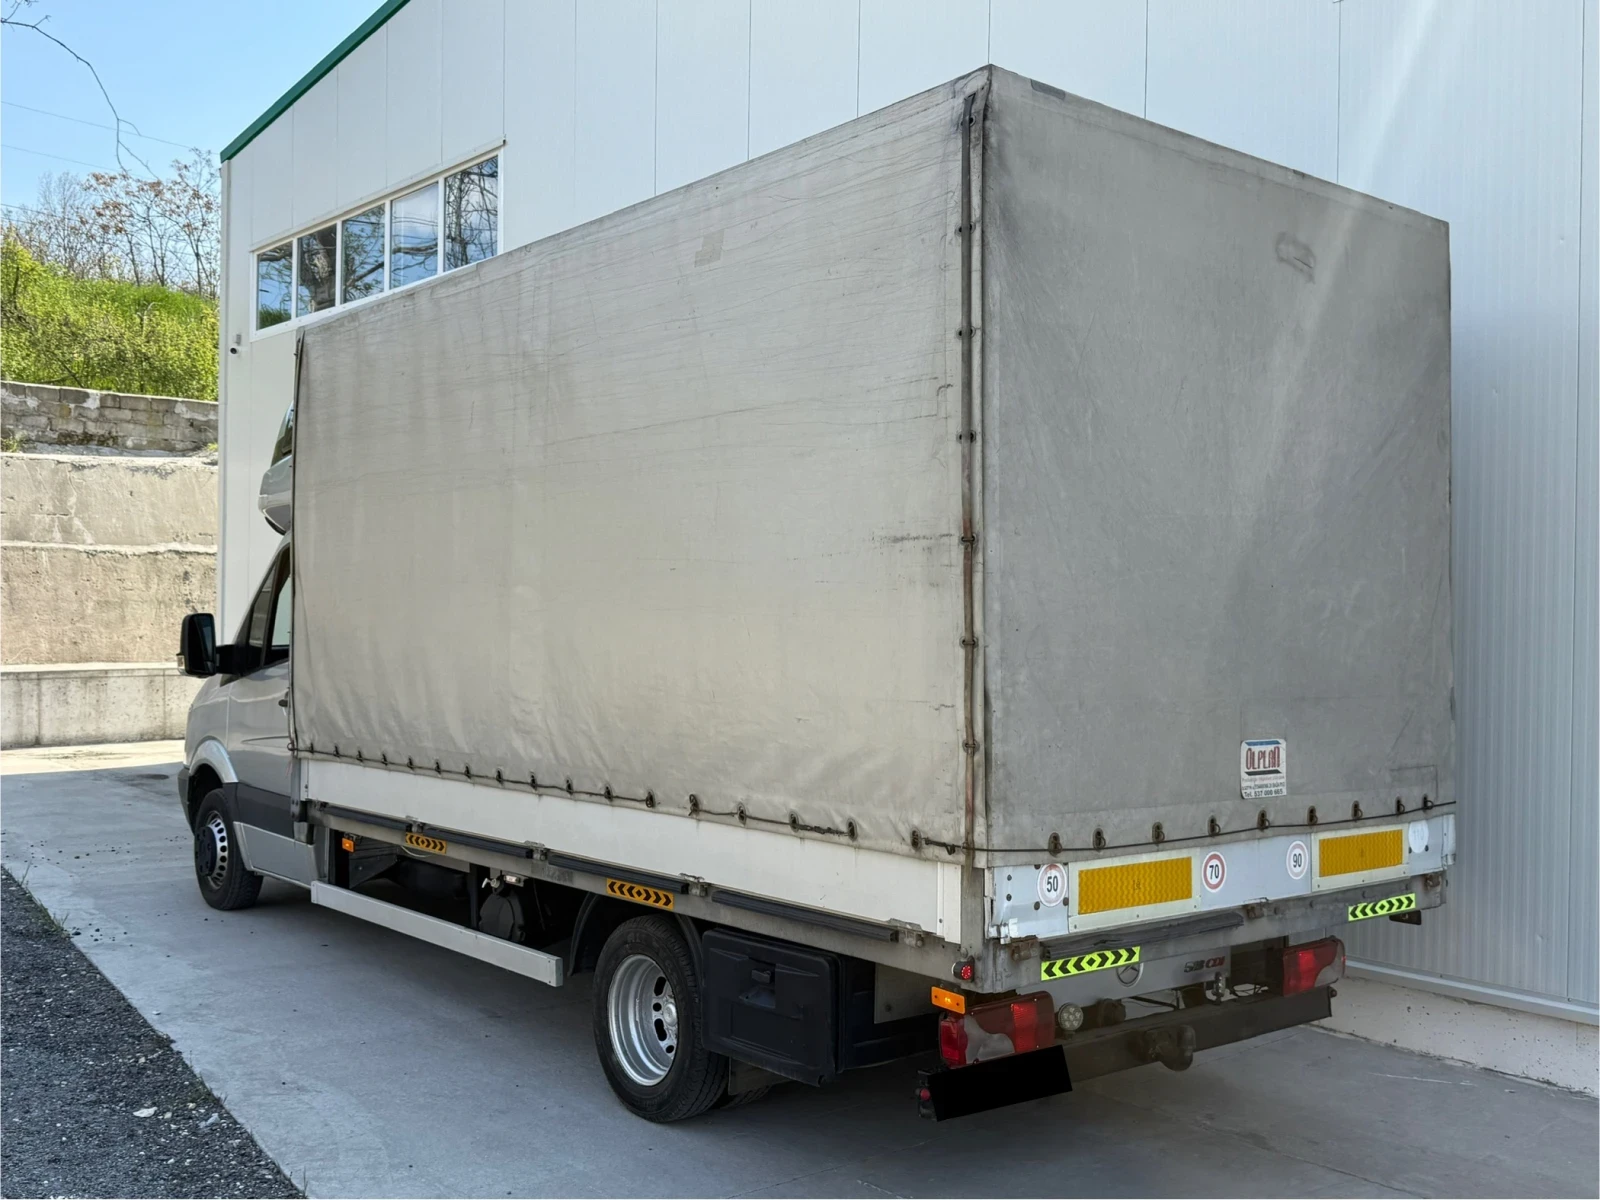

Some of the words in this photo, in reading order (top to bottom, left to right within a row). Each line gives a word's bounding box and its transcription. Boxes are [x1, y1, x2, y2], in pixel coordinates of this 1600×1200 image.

[1292, 853, 1303, 868] 90
[1209, 864, 1220, 880] 70
[1046, 875, 1059, 893] 50
[1205, 956, 1226, 969] CDI
